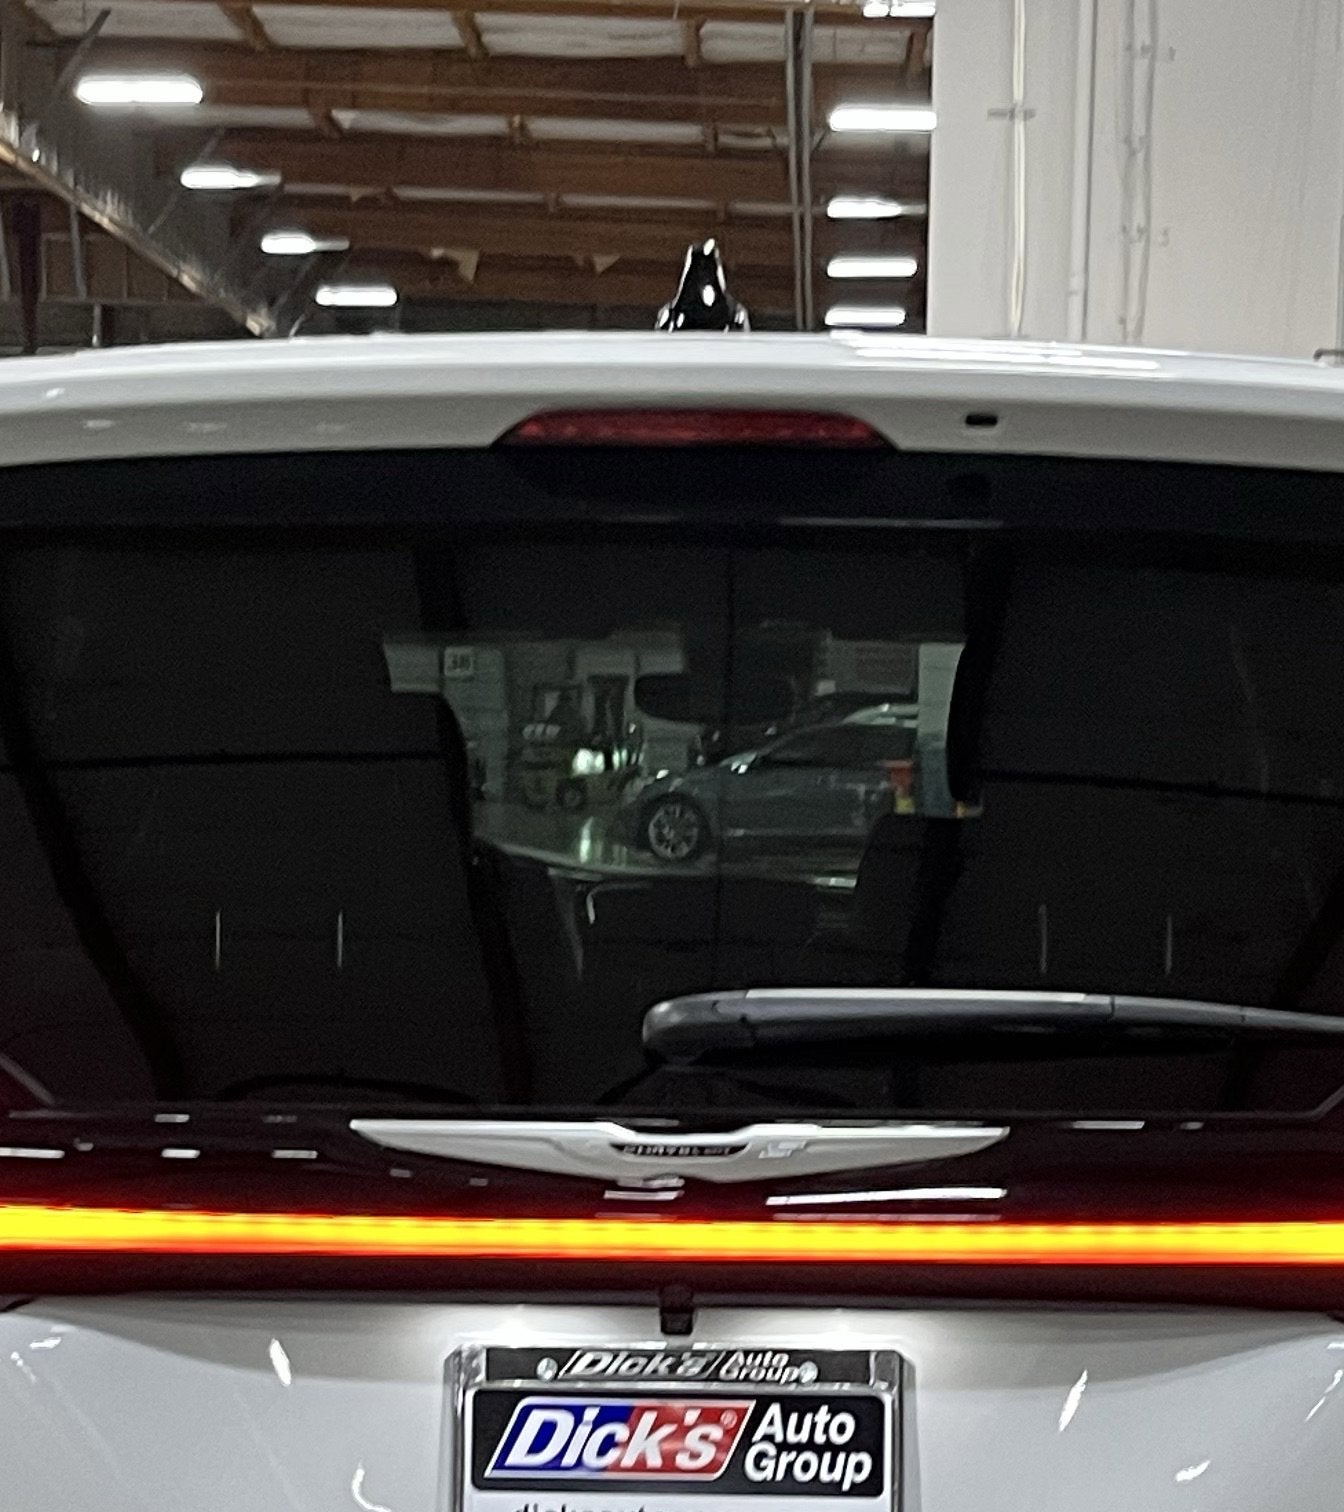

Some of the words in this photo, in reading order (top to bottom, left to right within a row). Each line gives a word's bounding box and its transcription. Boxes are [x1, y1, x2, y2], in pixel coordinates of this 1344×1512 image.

[718, 1358, 803, 1385] Group
[726, 1350, 790, 1368] Auto
[504, 1406, 726, 1472] Dick's
[752, 1402, 856, 1445] Auto
[744, 1445, 873, 1492] Group
